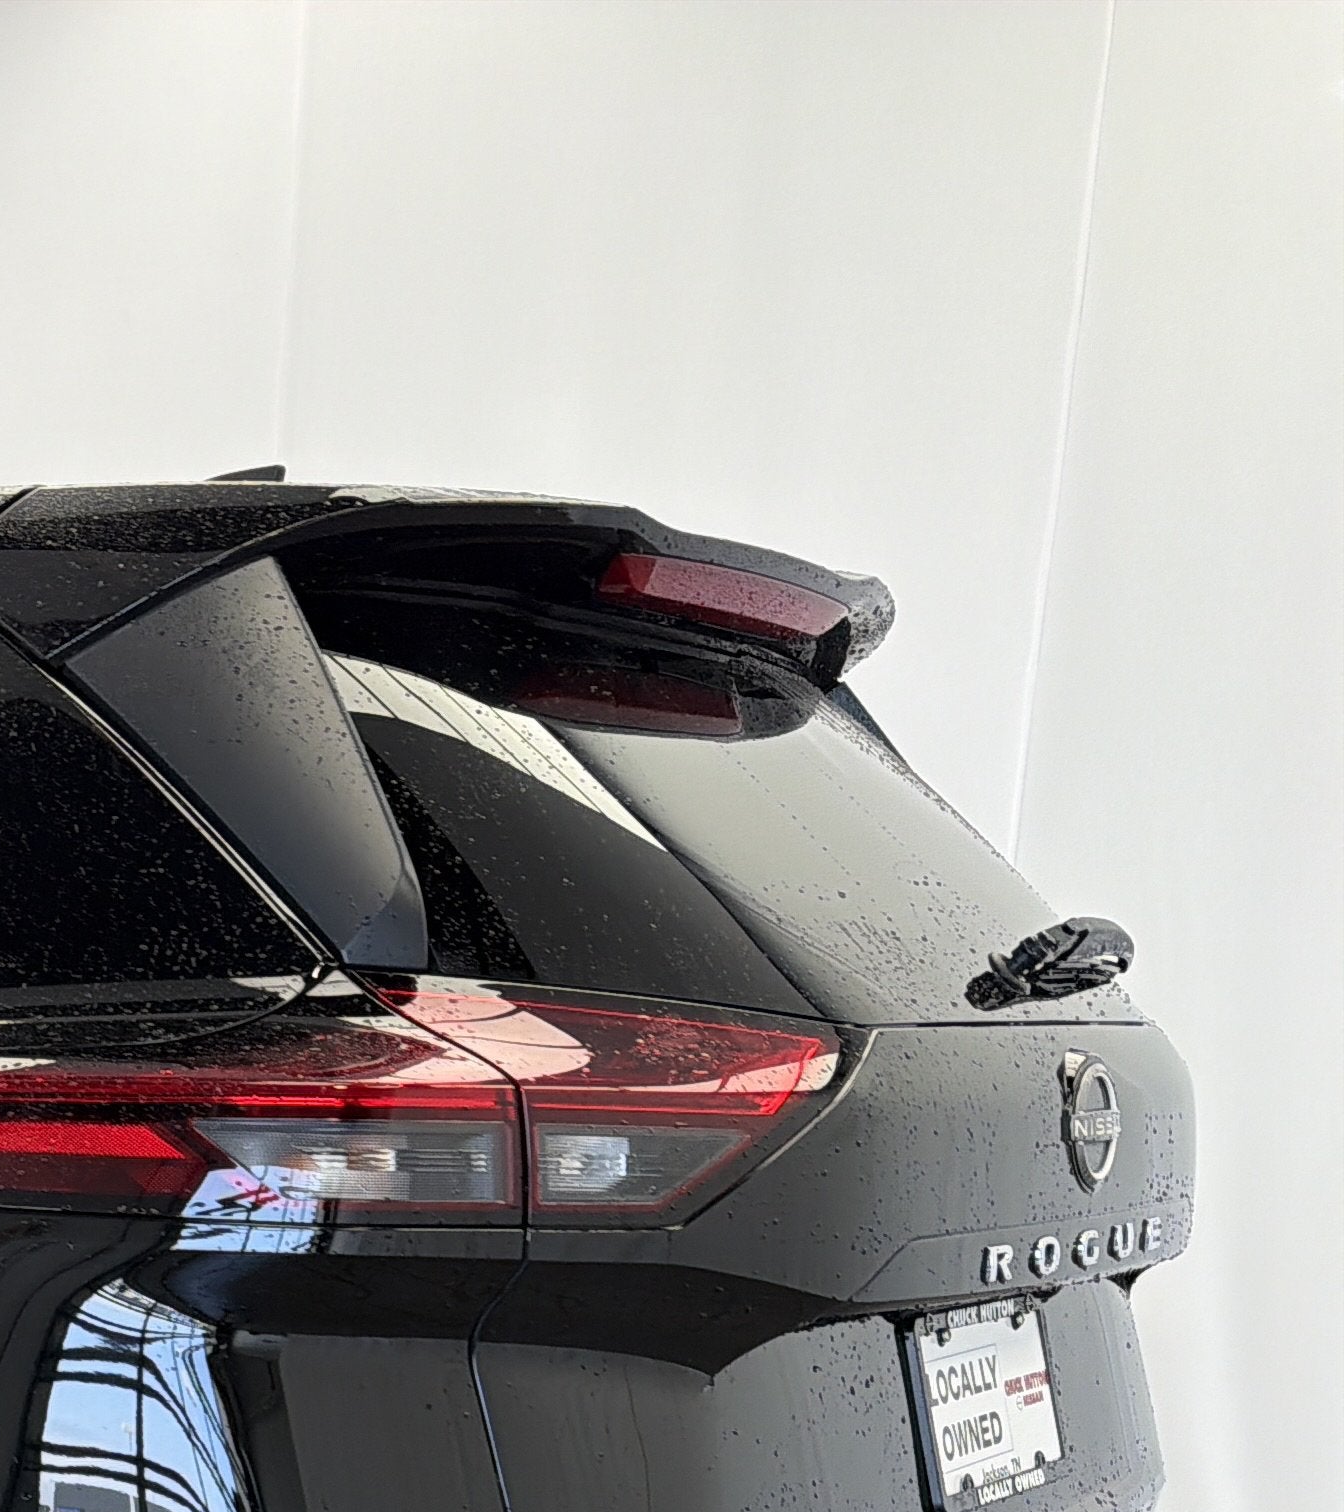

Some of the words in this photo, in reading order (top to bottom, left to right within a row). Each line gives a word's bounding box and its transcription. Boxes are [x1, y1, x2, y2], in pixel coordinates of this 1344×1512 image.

[1074, 1117, 1117, 1138] NISS
[982, 1216, 1163, 1284] ROGUE
[946, 1305, 978, 1328] CHUCK
[979, 1298, 1015, 1322] HUTTON
[924, 1354, 998, 1408] LOCALLY
[942, 1411, 1002, 1461] OWNED
[977, 1478, 1014, 1505] LOCALLY
[1014, 1468, 1046, 1492] OWNED
